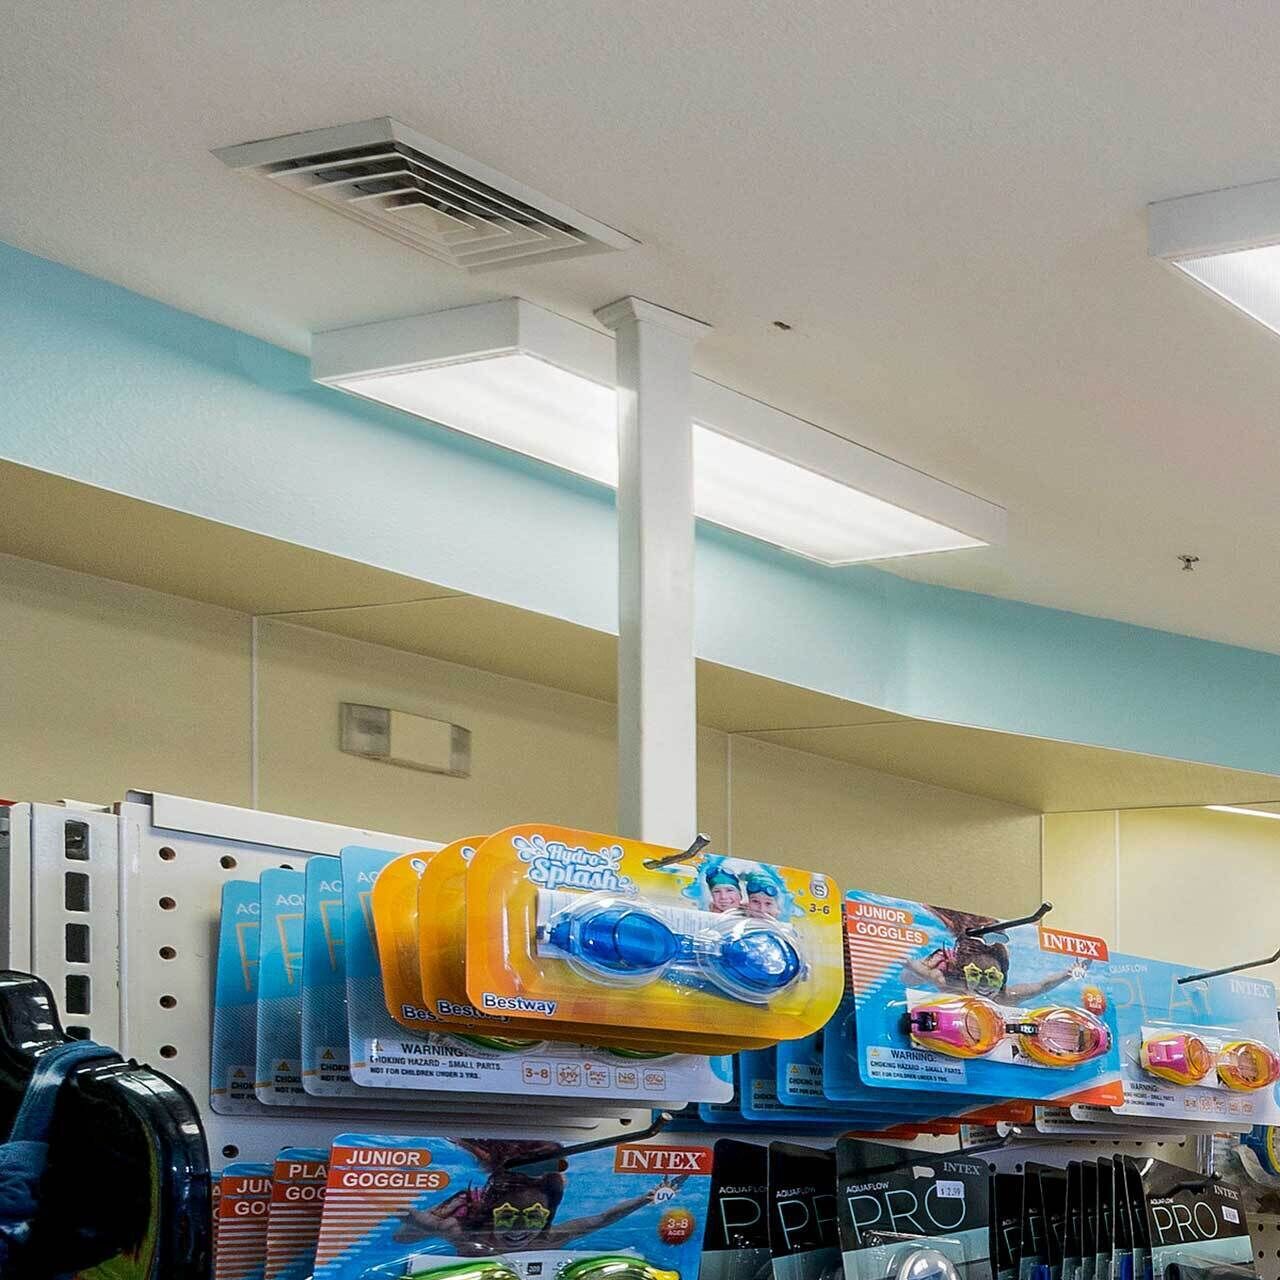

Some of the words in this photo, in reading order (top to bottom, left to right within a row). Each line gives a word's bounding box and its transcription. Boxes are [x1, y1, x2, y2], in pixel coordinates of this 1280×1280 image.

[546, 843, 601, 866] Hydro
[528, 857, 621, 890] Splash
[809, 904, 830, 916] 3-6
[855, 905, 906, 924] JUNIOR
[856, 923, 924, 944] GOGGLES
[1043, 933, 1101, 957] INTEX
[1230, 979, 1270, 998] INTEX
[483, 993, 557, 1017] Bestway
[407, 1056, 440, 1068] HAZARD
[448, 1059, 475, 1069] SMALL
[870, 1061, 897, 1070] CHOKING
[897, 1063, 920, 1072] HAZARD
[924, 1065, 946, 1073] SMALL
[385, 1067, 400, 1075] FOR
[401, 1068, 435, 1077] CHILDREN
[525, 1067, 549, 1079] 3-8
[346, 1150, 421, 1167] JUNIOR
[620, 1149, 703, 1171] INTEX
[289, 1165, 328, 1178] PLA
[943, 1161, 981, 1177] INTEX
[342, 1172, 441, 1189] GOGGLES
[846, 1181, 890, 1193] AQUAFLOW
[657, 1191, 674, 1201] UV
[776, 1187, 817, 1198] AQUAFLOW
[1213, 1185, 1239, 1200] INTEX
[847, 1184, 967, 1245] PRO
[667, 1218, 689, 1230] 3-8
[1152, 1202, 1218, 1244] PRO
